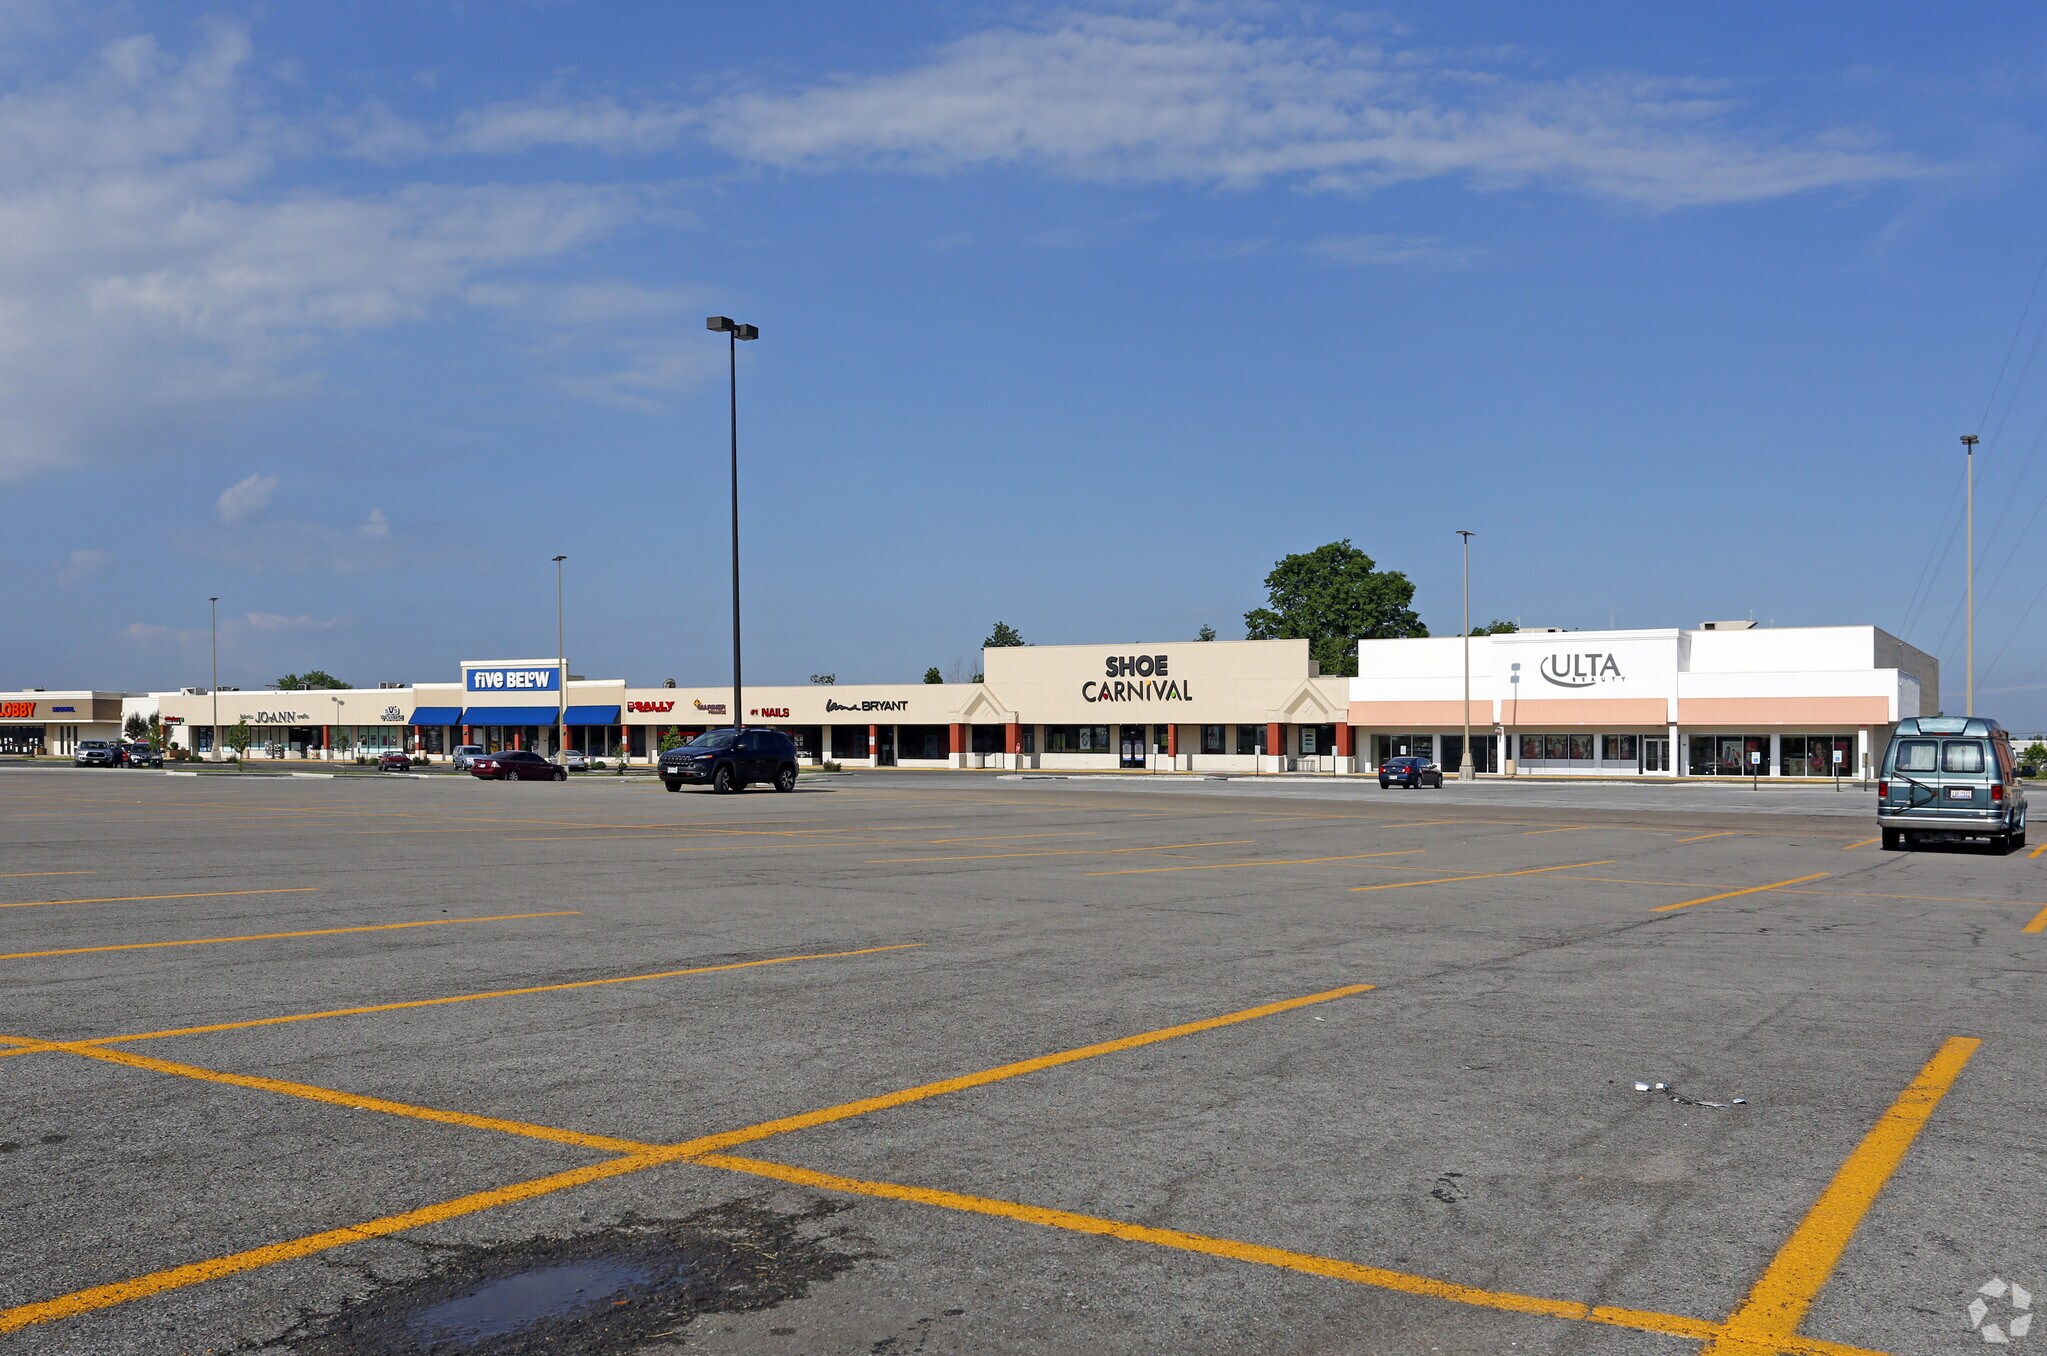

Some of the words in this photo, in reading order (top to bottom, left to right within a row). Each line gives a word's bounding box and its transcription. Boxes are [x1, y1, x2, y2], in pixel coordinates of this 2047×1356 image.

[1105, 655, 1168, 678] SHOE
[1551, 653, 1621, 677] ULTA
[1081, 679, 1193, 703] CARNIVAL
[634, 701, 676, 713] SALLY
[761, 707, 790, 718] NAILS
[861, 700, 909, 712] BRYANT
